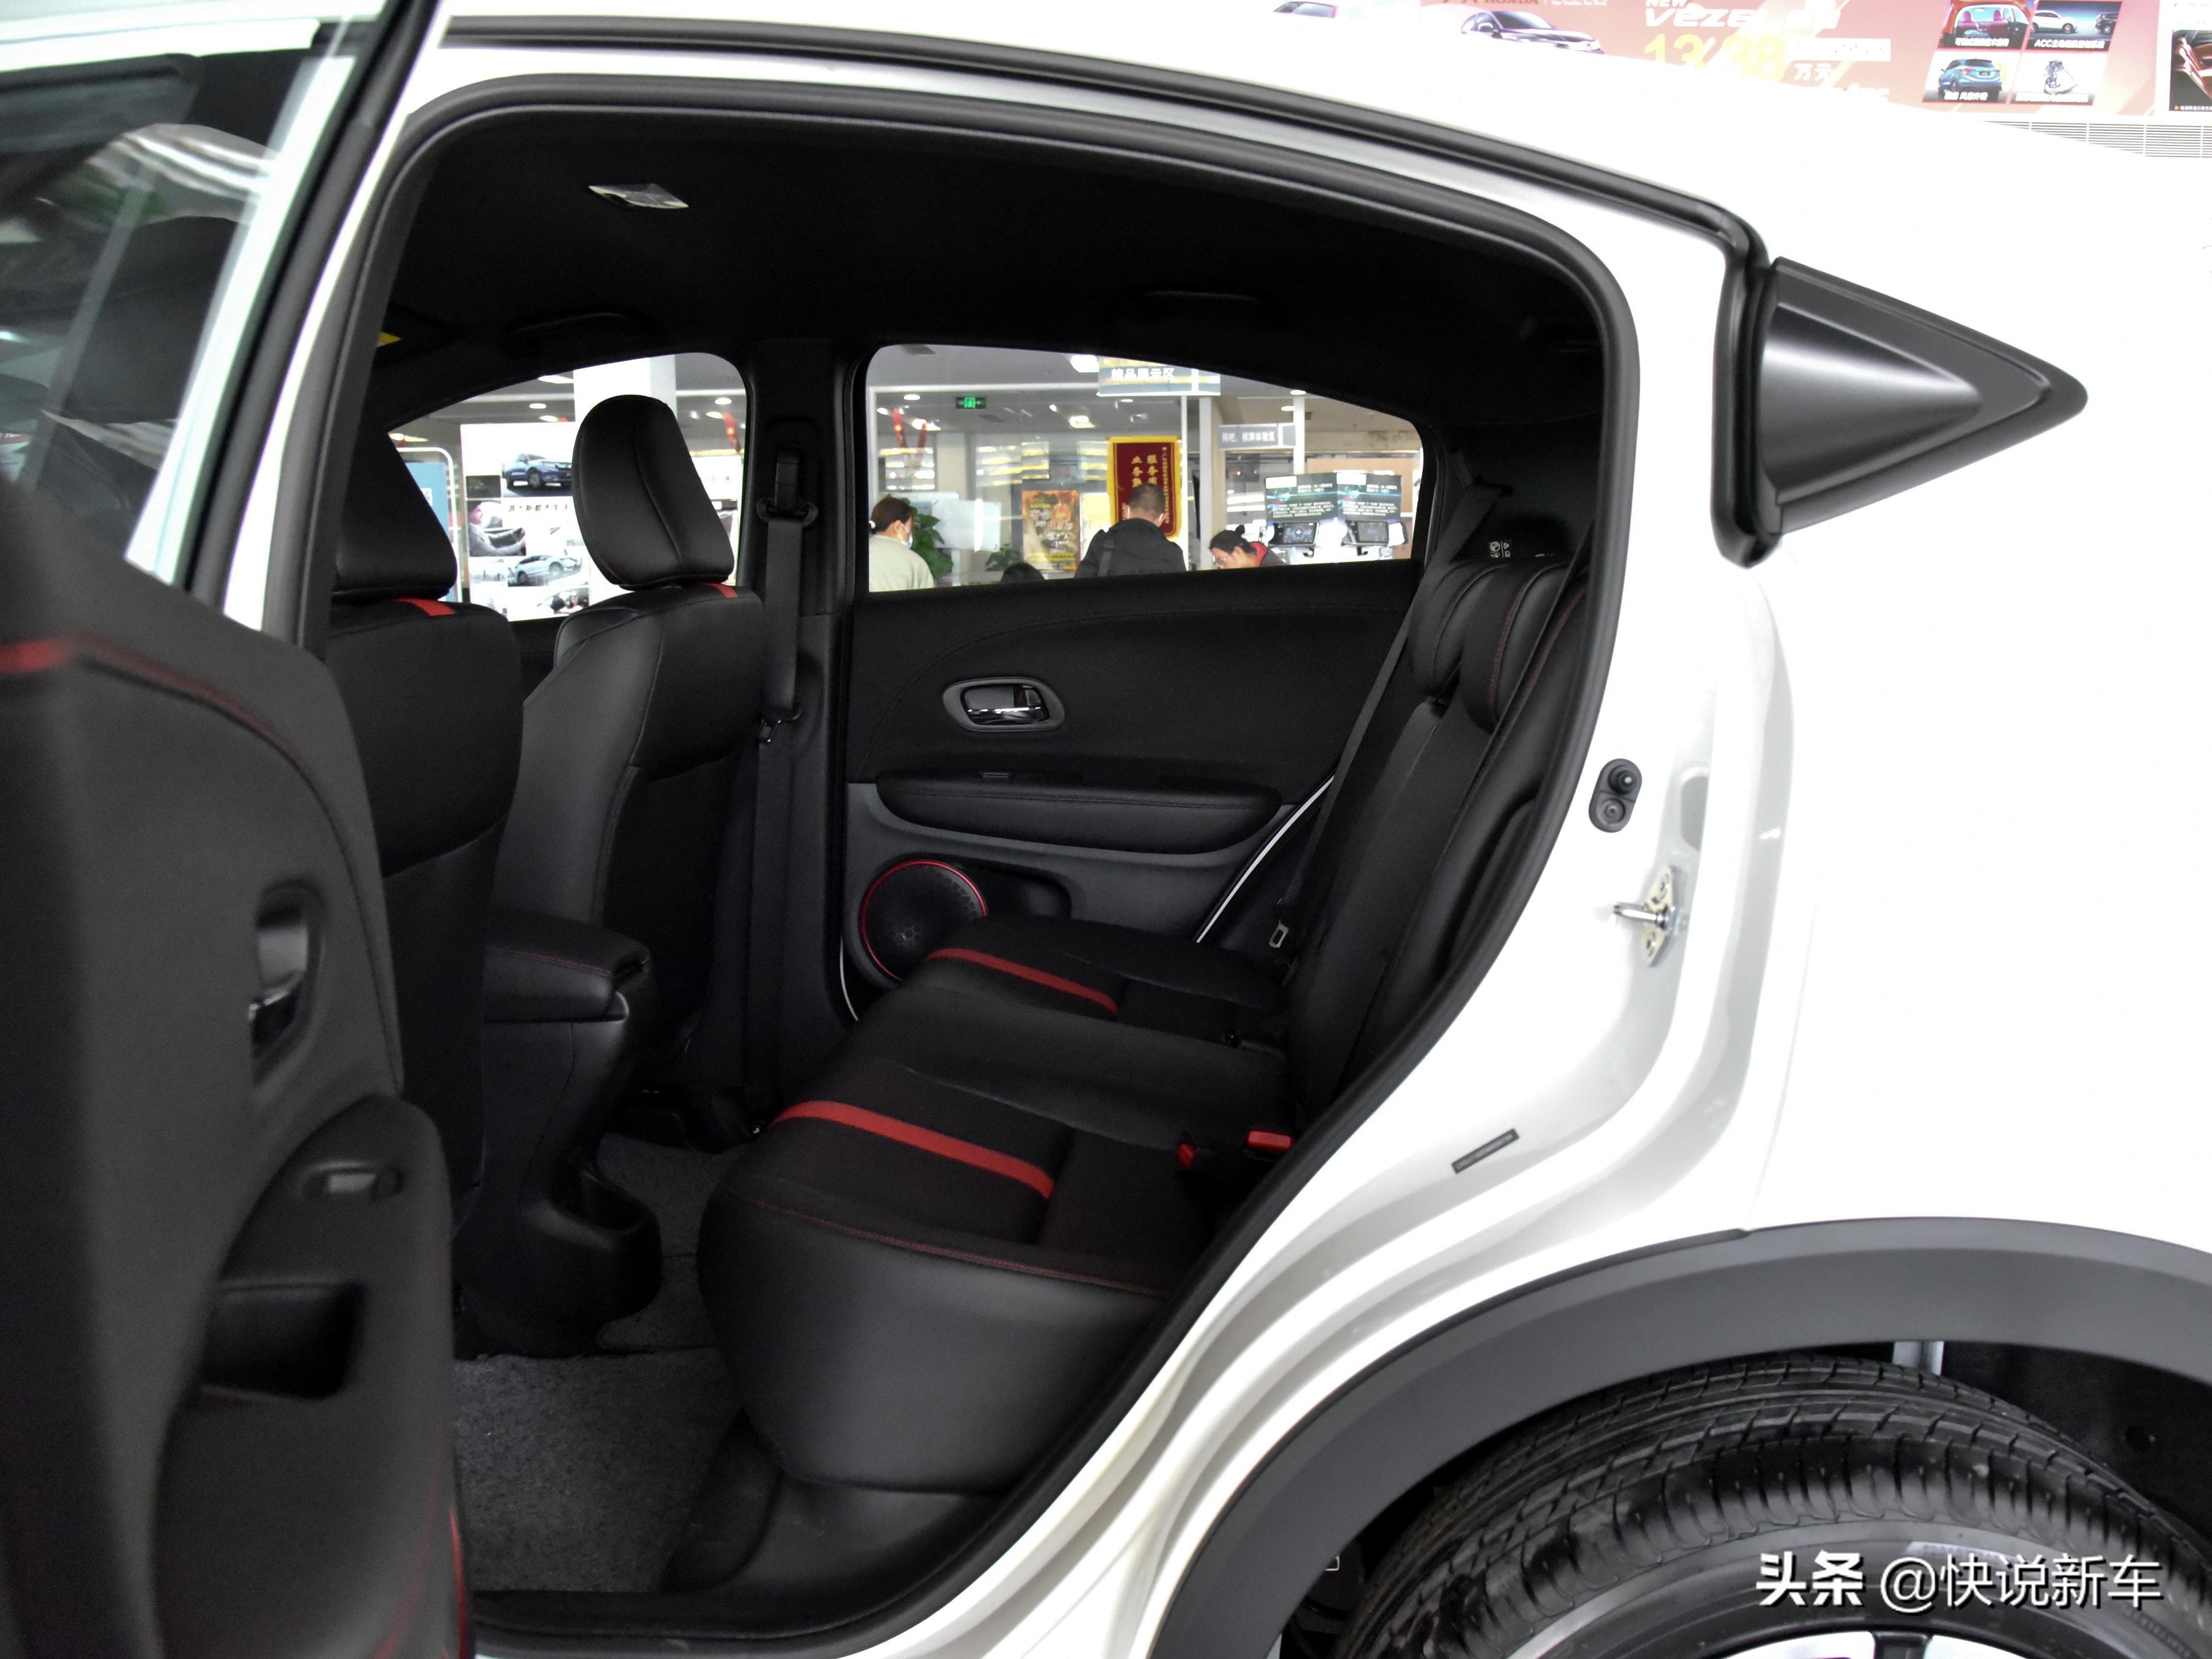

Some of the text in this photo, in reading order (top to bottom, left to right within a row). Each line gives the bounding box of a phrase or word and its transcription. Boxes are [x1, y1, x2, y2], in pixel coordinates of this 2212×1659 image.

[1794, 63, 1832, 81] 万元
[1111, 367, 1174, 381] 精品展示区
